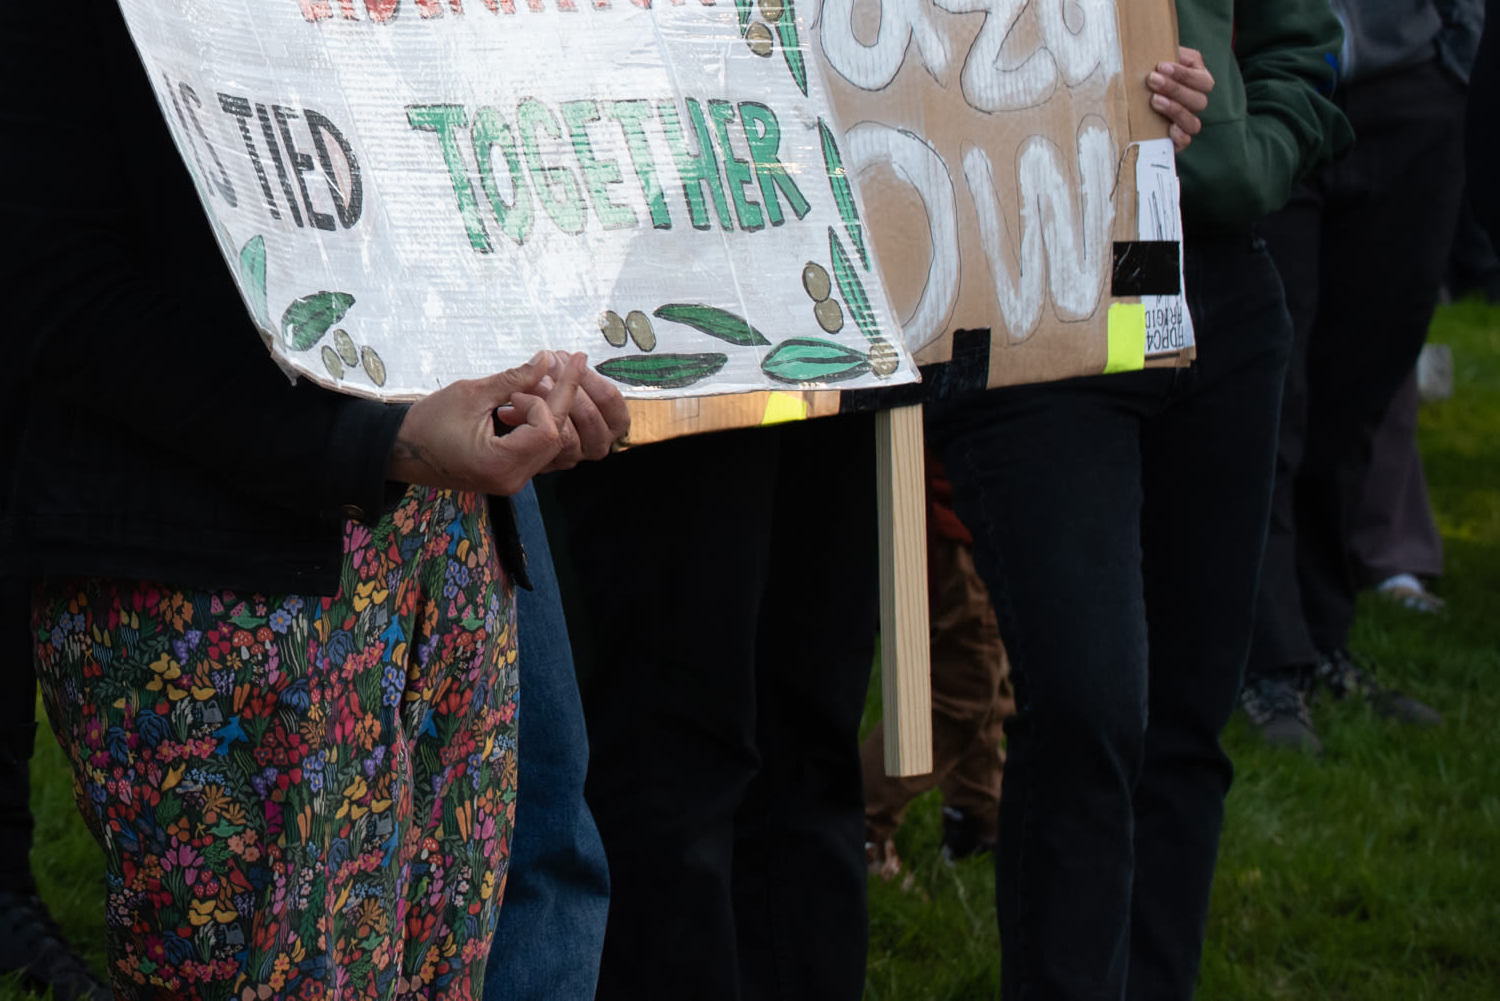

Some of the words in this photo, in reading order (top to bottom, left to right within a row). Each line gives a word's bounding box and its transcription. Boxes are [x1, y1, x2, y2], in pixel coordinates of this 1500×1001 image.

[218, 92, 363, 232] TIED
[405, 96, 811, 254] TOGETHER
[843, 113, 1122, 355] OW
